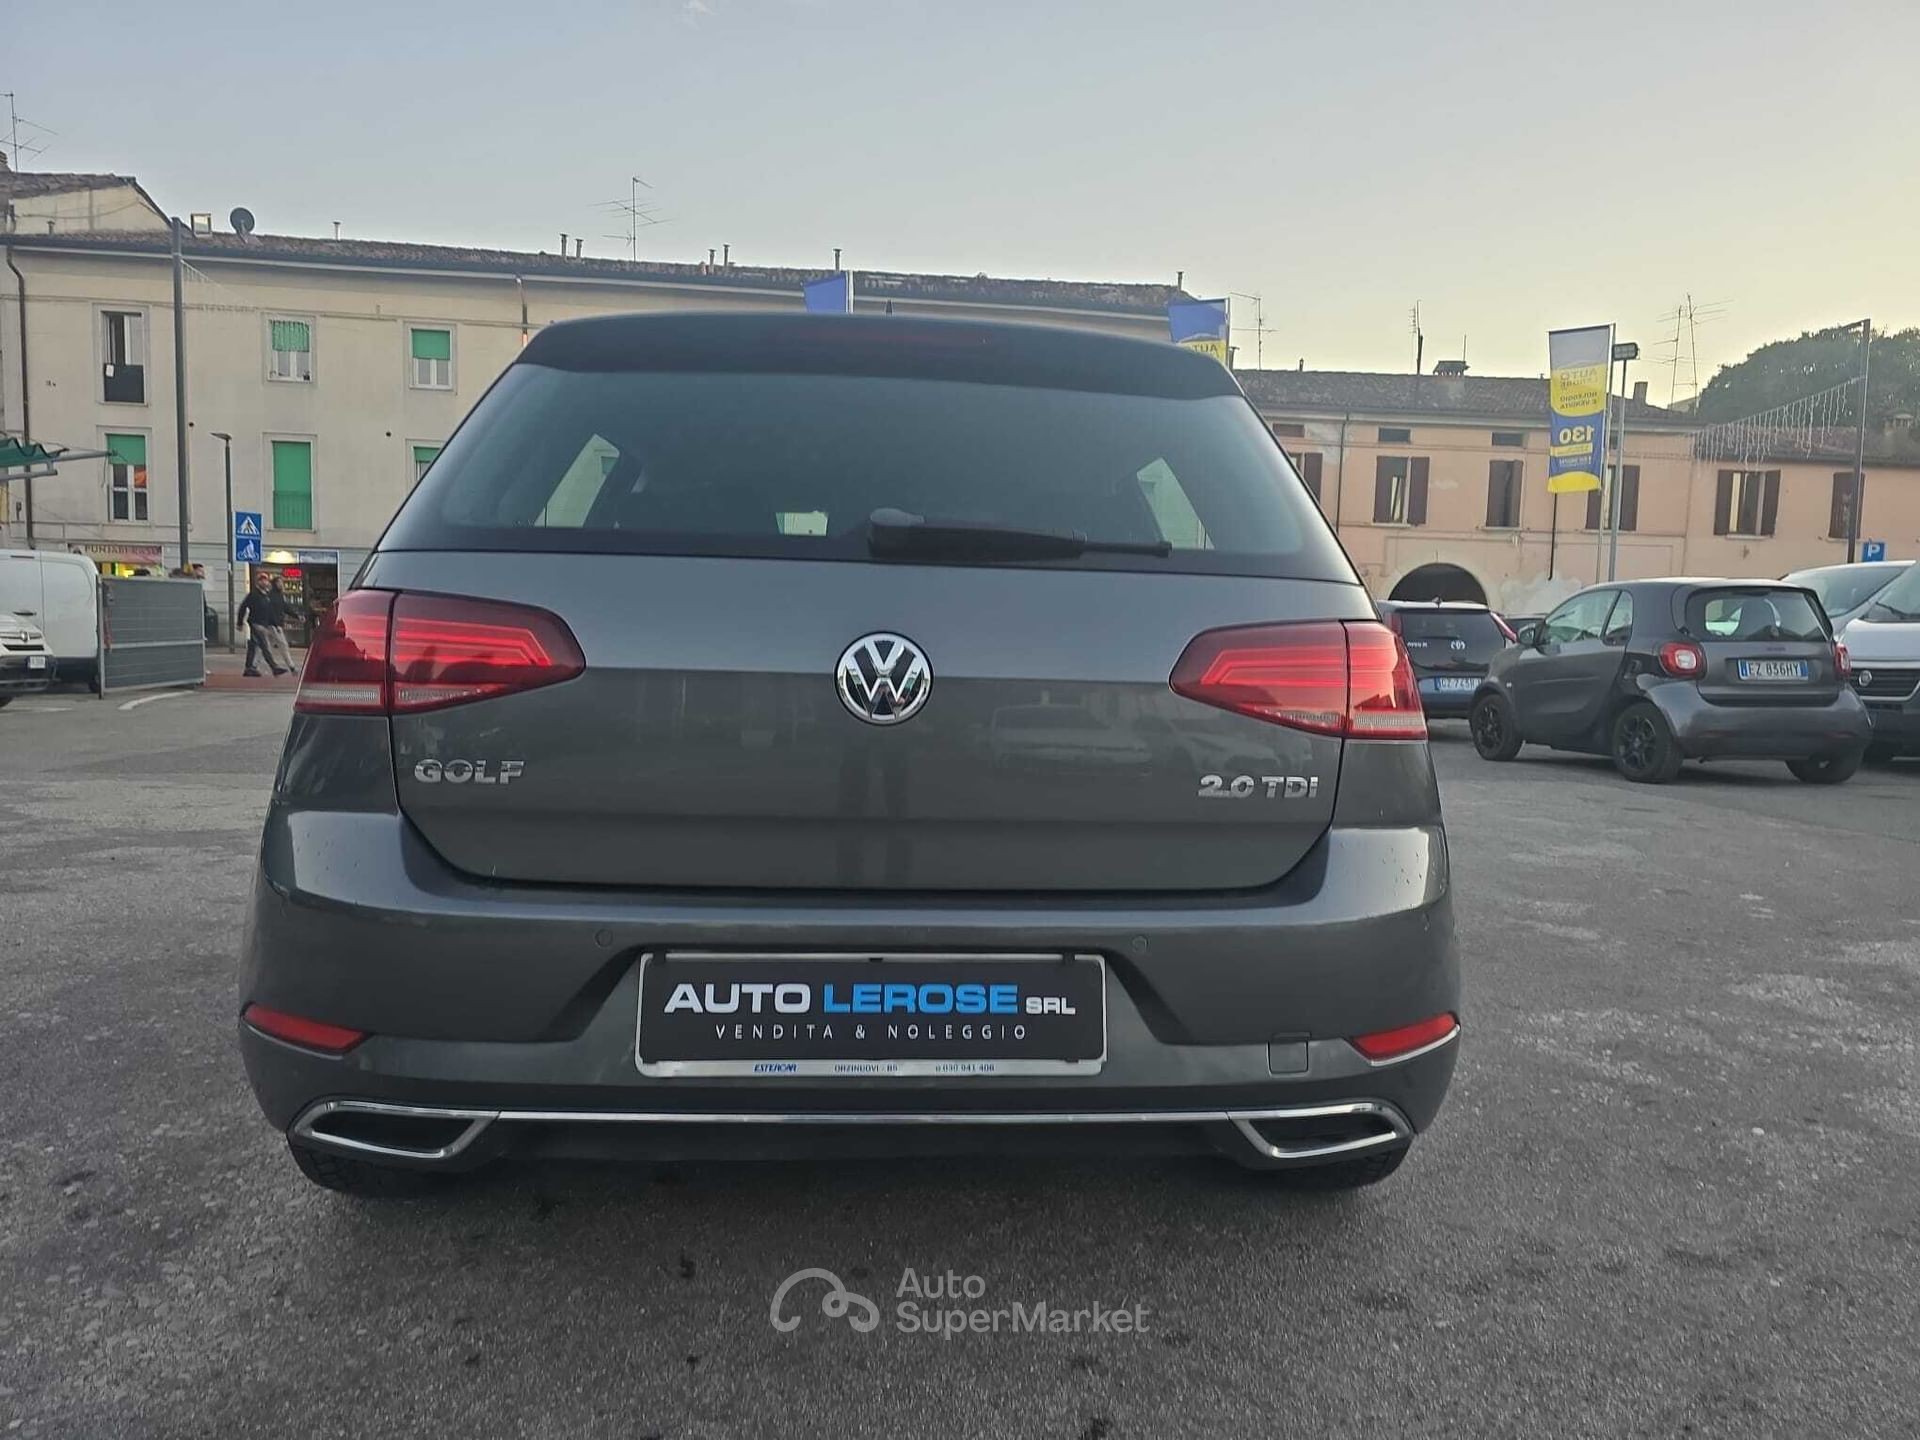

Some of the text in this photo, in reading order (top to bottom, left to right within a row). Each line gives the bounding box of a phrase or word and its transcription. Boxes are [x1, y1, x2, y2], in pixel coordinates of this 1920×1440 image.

[1867, 543, 1881, 557] P
[414, 759, 524, 784] GOLF
[1198, 774, 1319, 798] 2.0 TDI
[663, 983, 1076, 1015] AUTO LEROSE SRL
[715, 1024, 1028, 1040] VENDITA & NOLEGGIO
